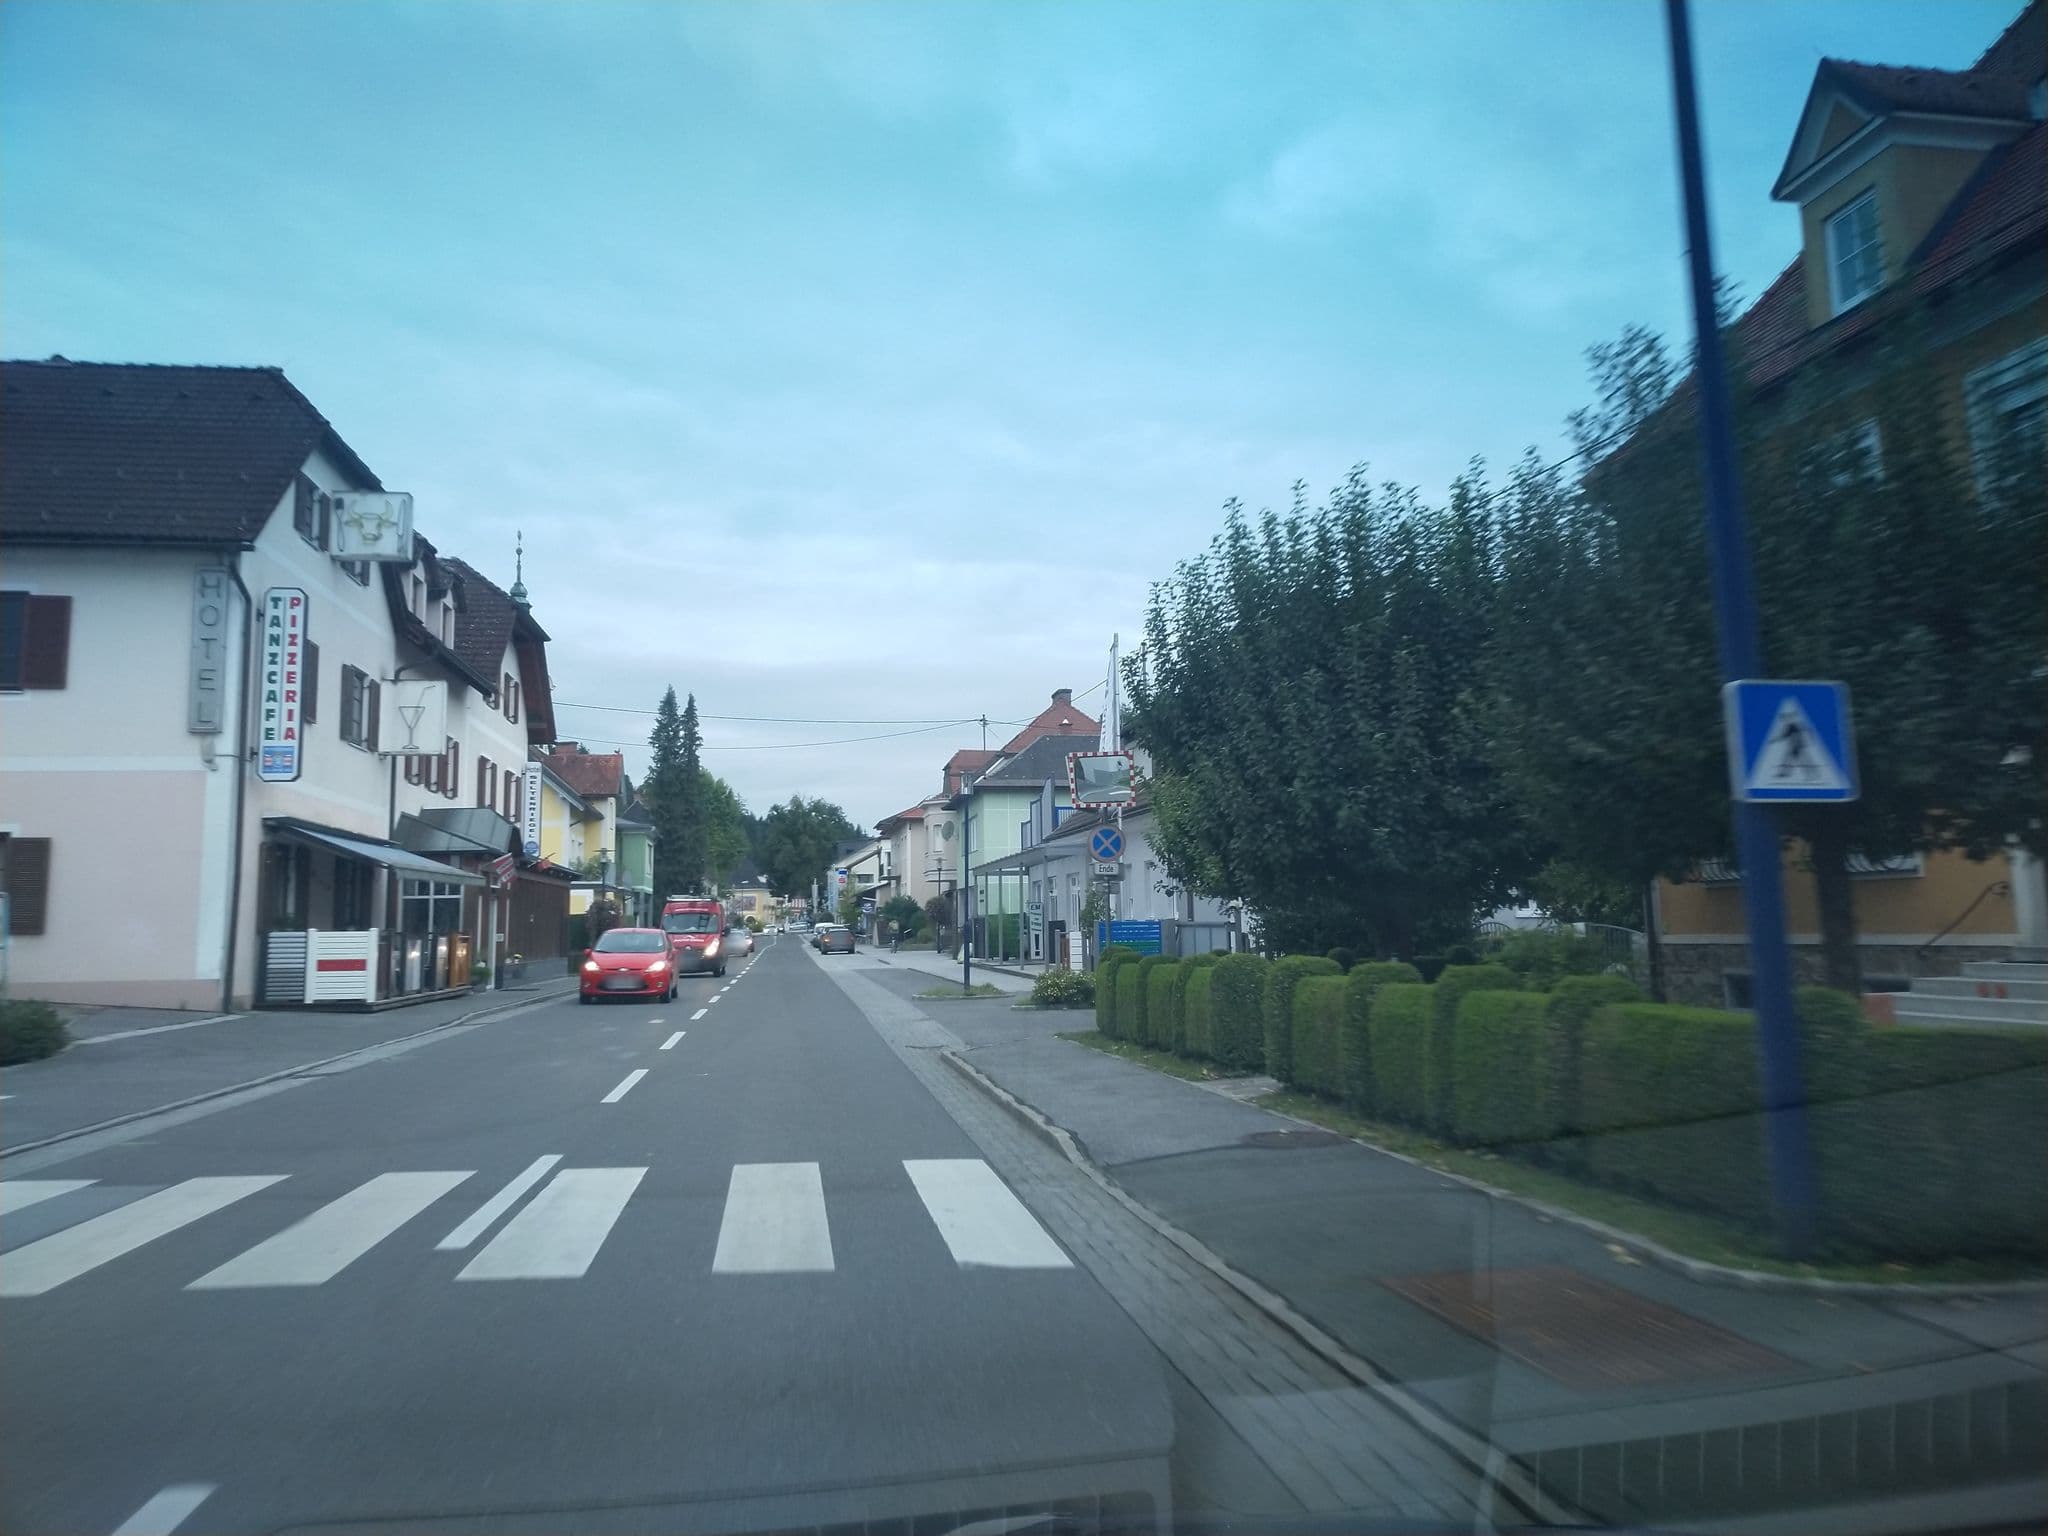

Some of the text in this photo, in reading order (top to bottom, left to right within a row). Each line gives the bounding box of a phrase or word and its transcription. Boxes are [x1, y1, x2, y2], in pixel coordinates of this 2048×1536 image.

[199, 576, 221, 723] HOTEL
[264, 597, 282, 741] TANZCAFE
[284, 597, 301, 741] PIZZERIA
[1098, 864, 1114, 873] Ende
